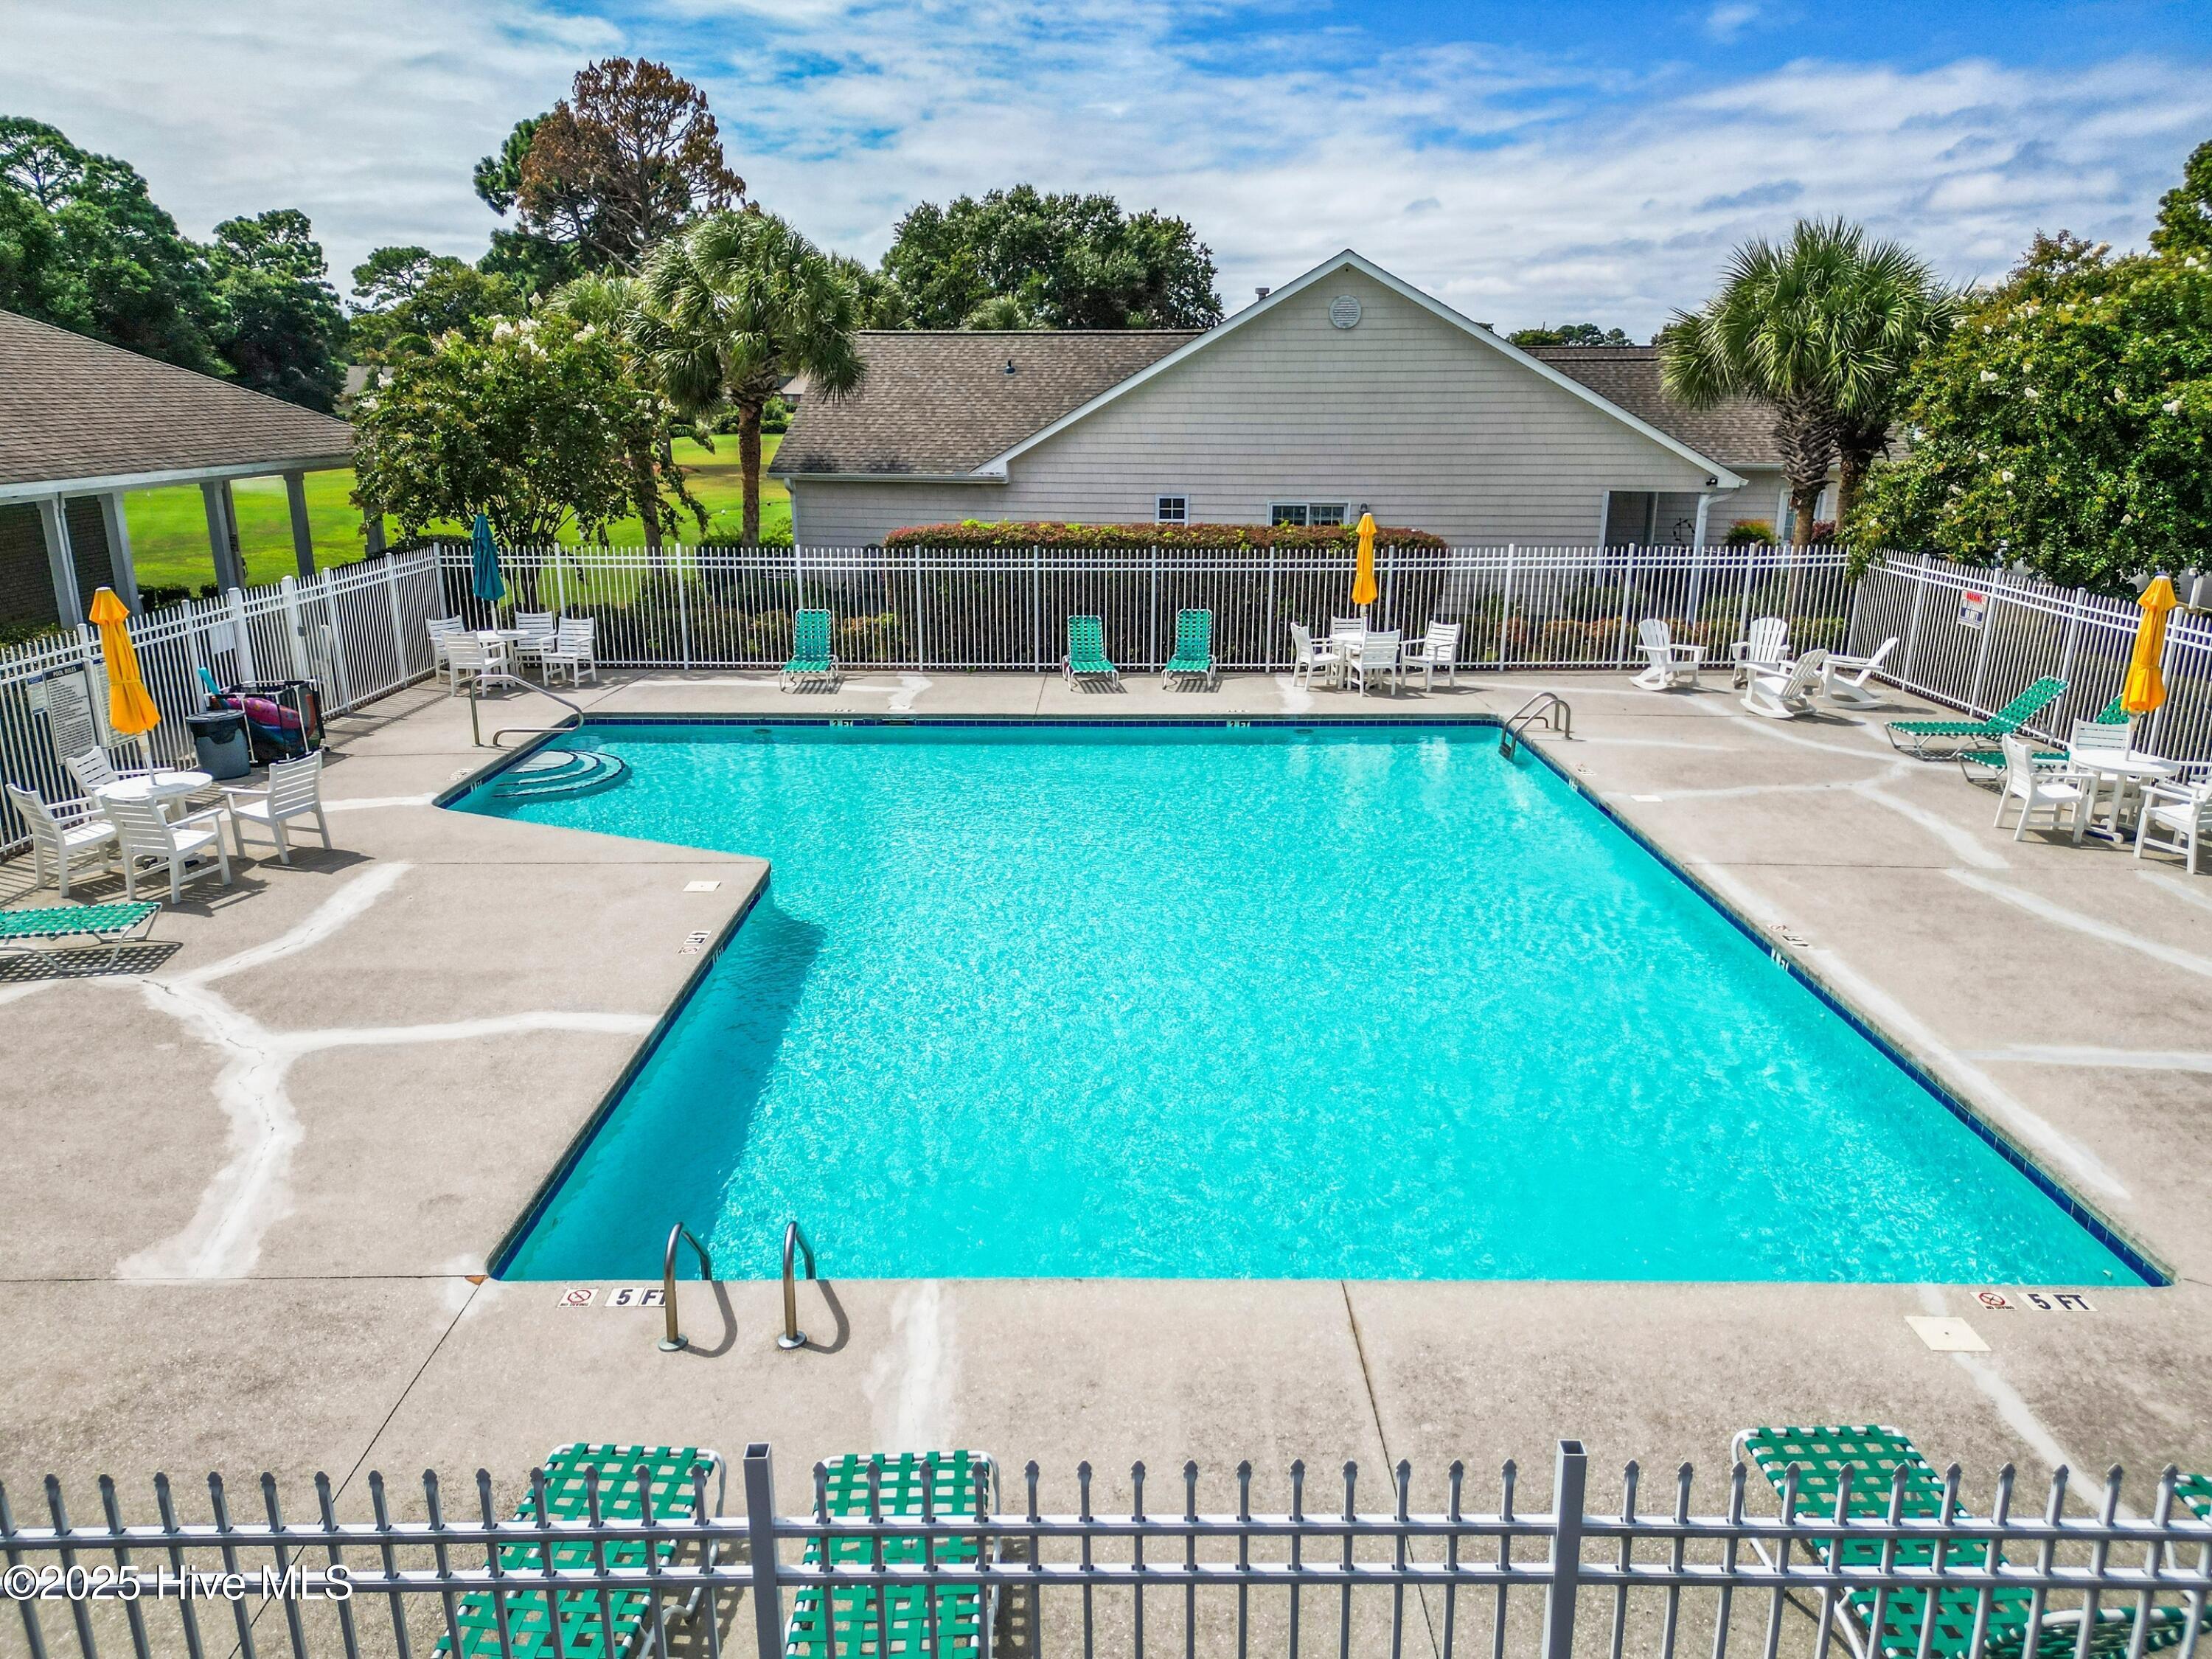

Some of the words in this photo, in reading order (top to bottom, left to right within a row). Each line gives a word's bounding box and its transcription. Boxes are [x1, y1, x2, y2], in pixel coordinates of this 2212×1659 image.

[616, 1289, 633, 1305] 5
[2027, 1293, 2051, 1310] 5
[2052, 1293, 2090, 1310] FT
